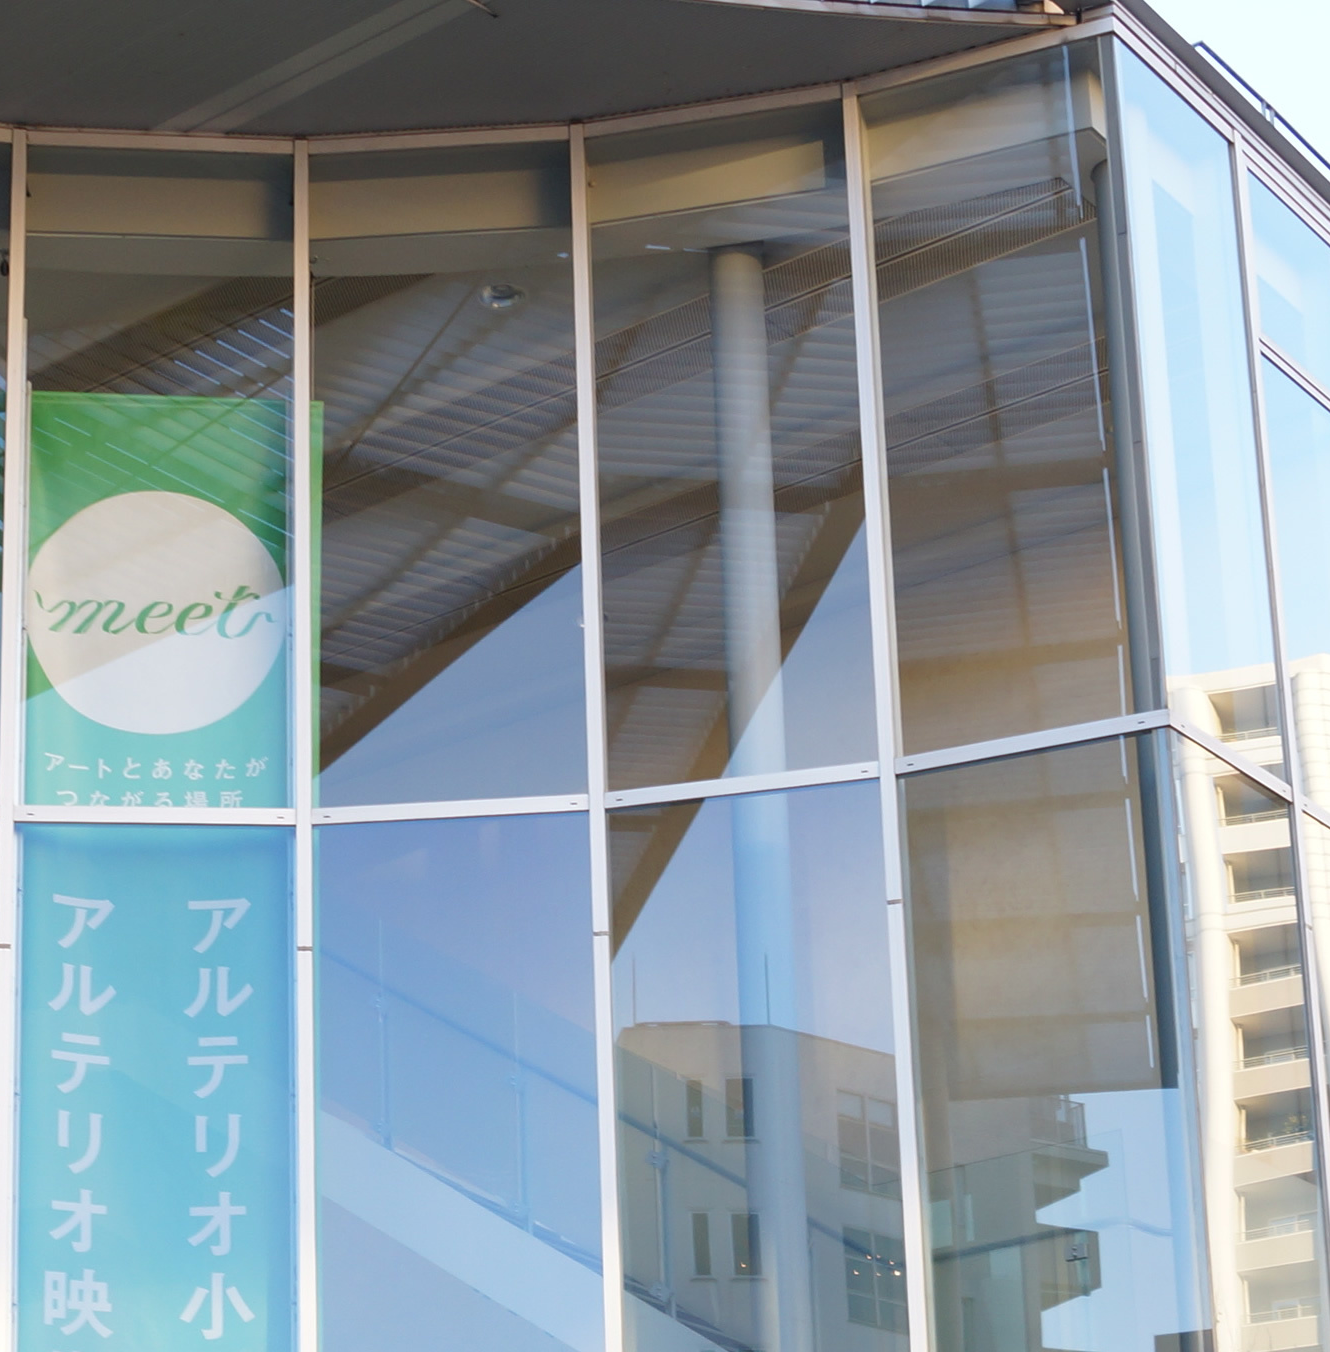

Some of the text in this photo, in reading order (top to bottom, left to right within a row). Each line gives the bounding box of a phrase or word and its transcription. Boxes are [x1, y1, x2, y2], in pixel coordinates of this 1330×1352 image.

[33, 585, 277, 640] meet
[44, 752, 269, 780] アートとあなたが
